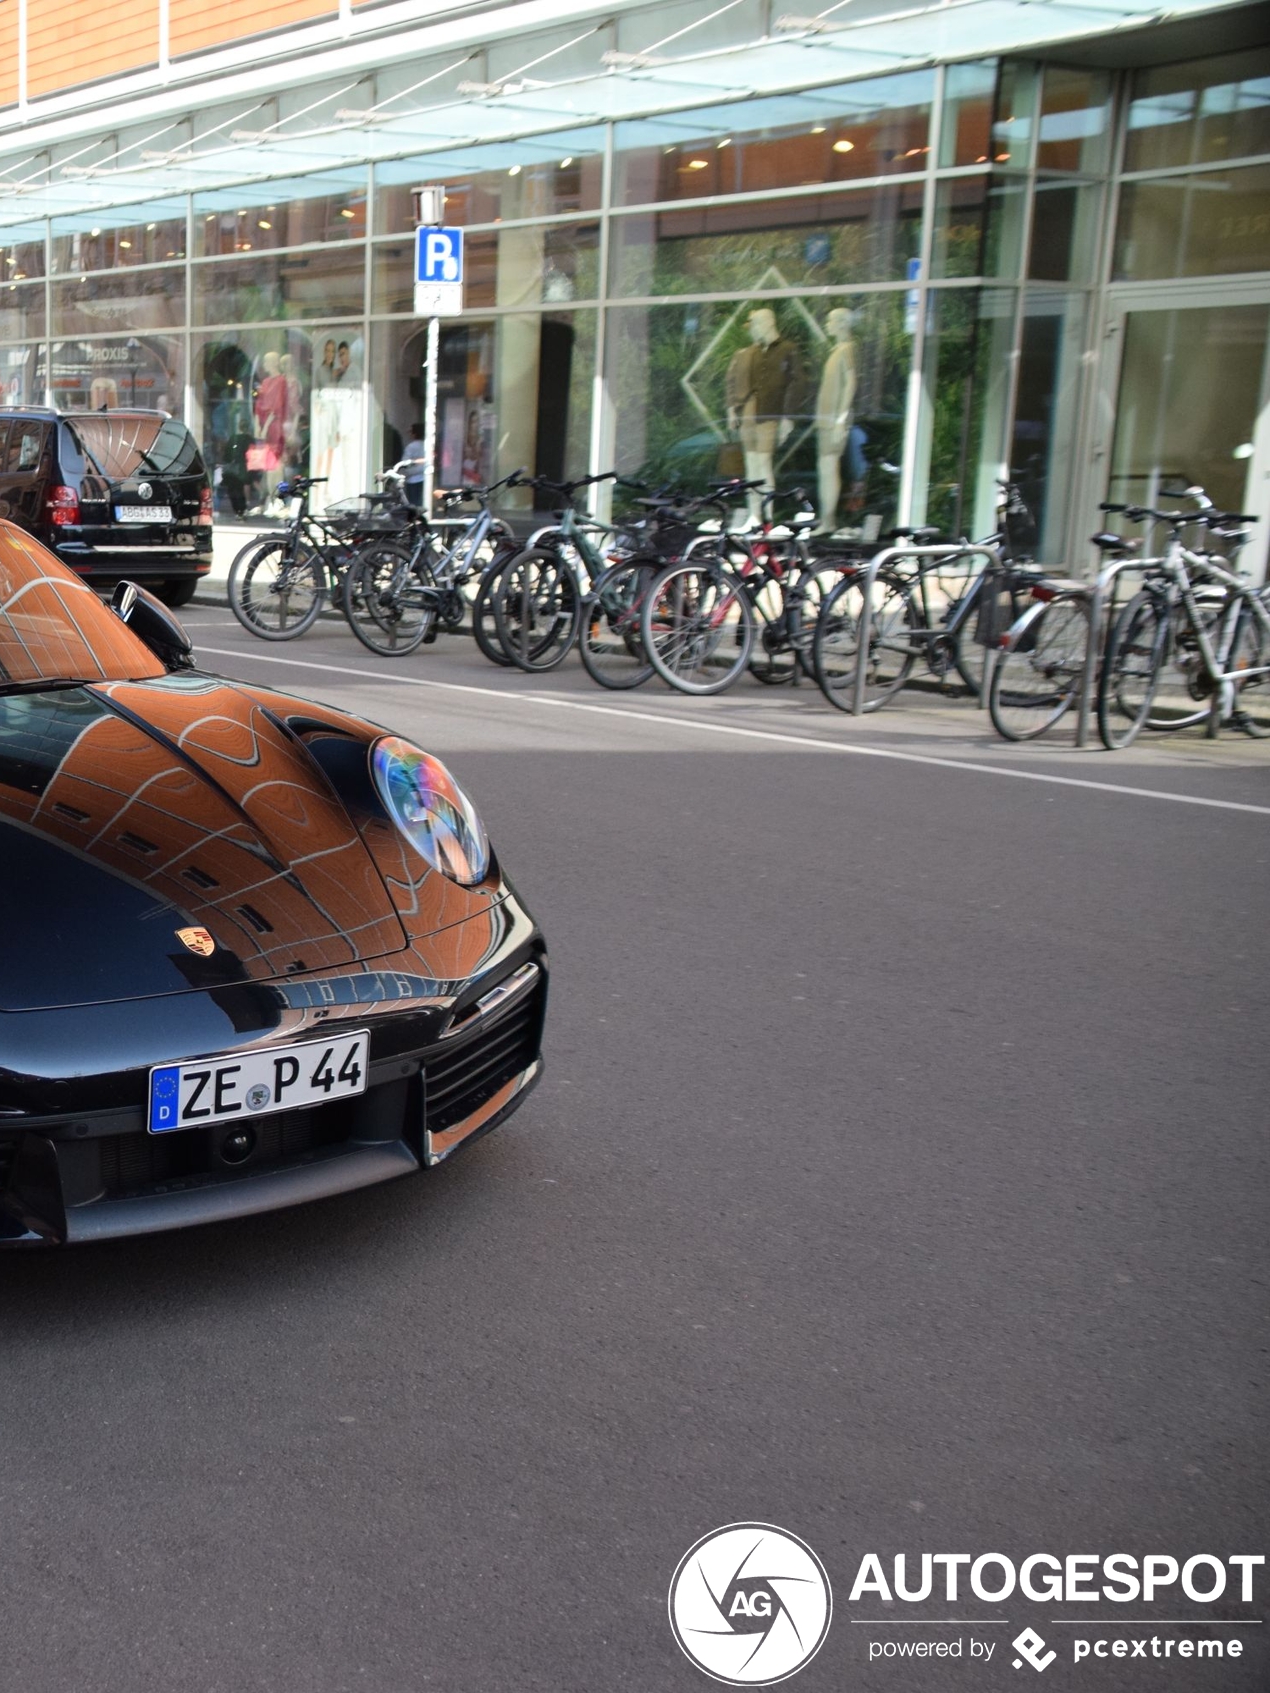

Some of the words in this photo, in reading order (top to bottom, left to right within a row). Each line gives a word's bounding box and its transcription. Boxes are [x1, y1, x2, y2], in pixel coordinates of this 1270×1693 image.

[122, 506, 141, 518] ABG
[146, 506, 158, 518] AS
[159, 506, 170, 518] 33
[159, 1106, 171, 1122] D
[181, 1064, 243, 1120] ZE
[273, 1055, 301, 1104] P
[310, 1041, 362, 1094] 44
